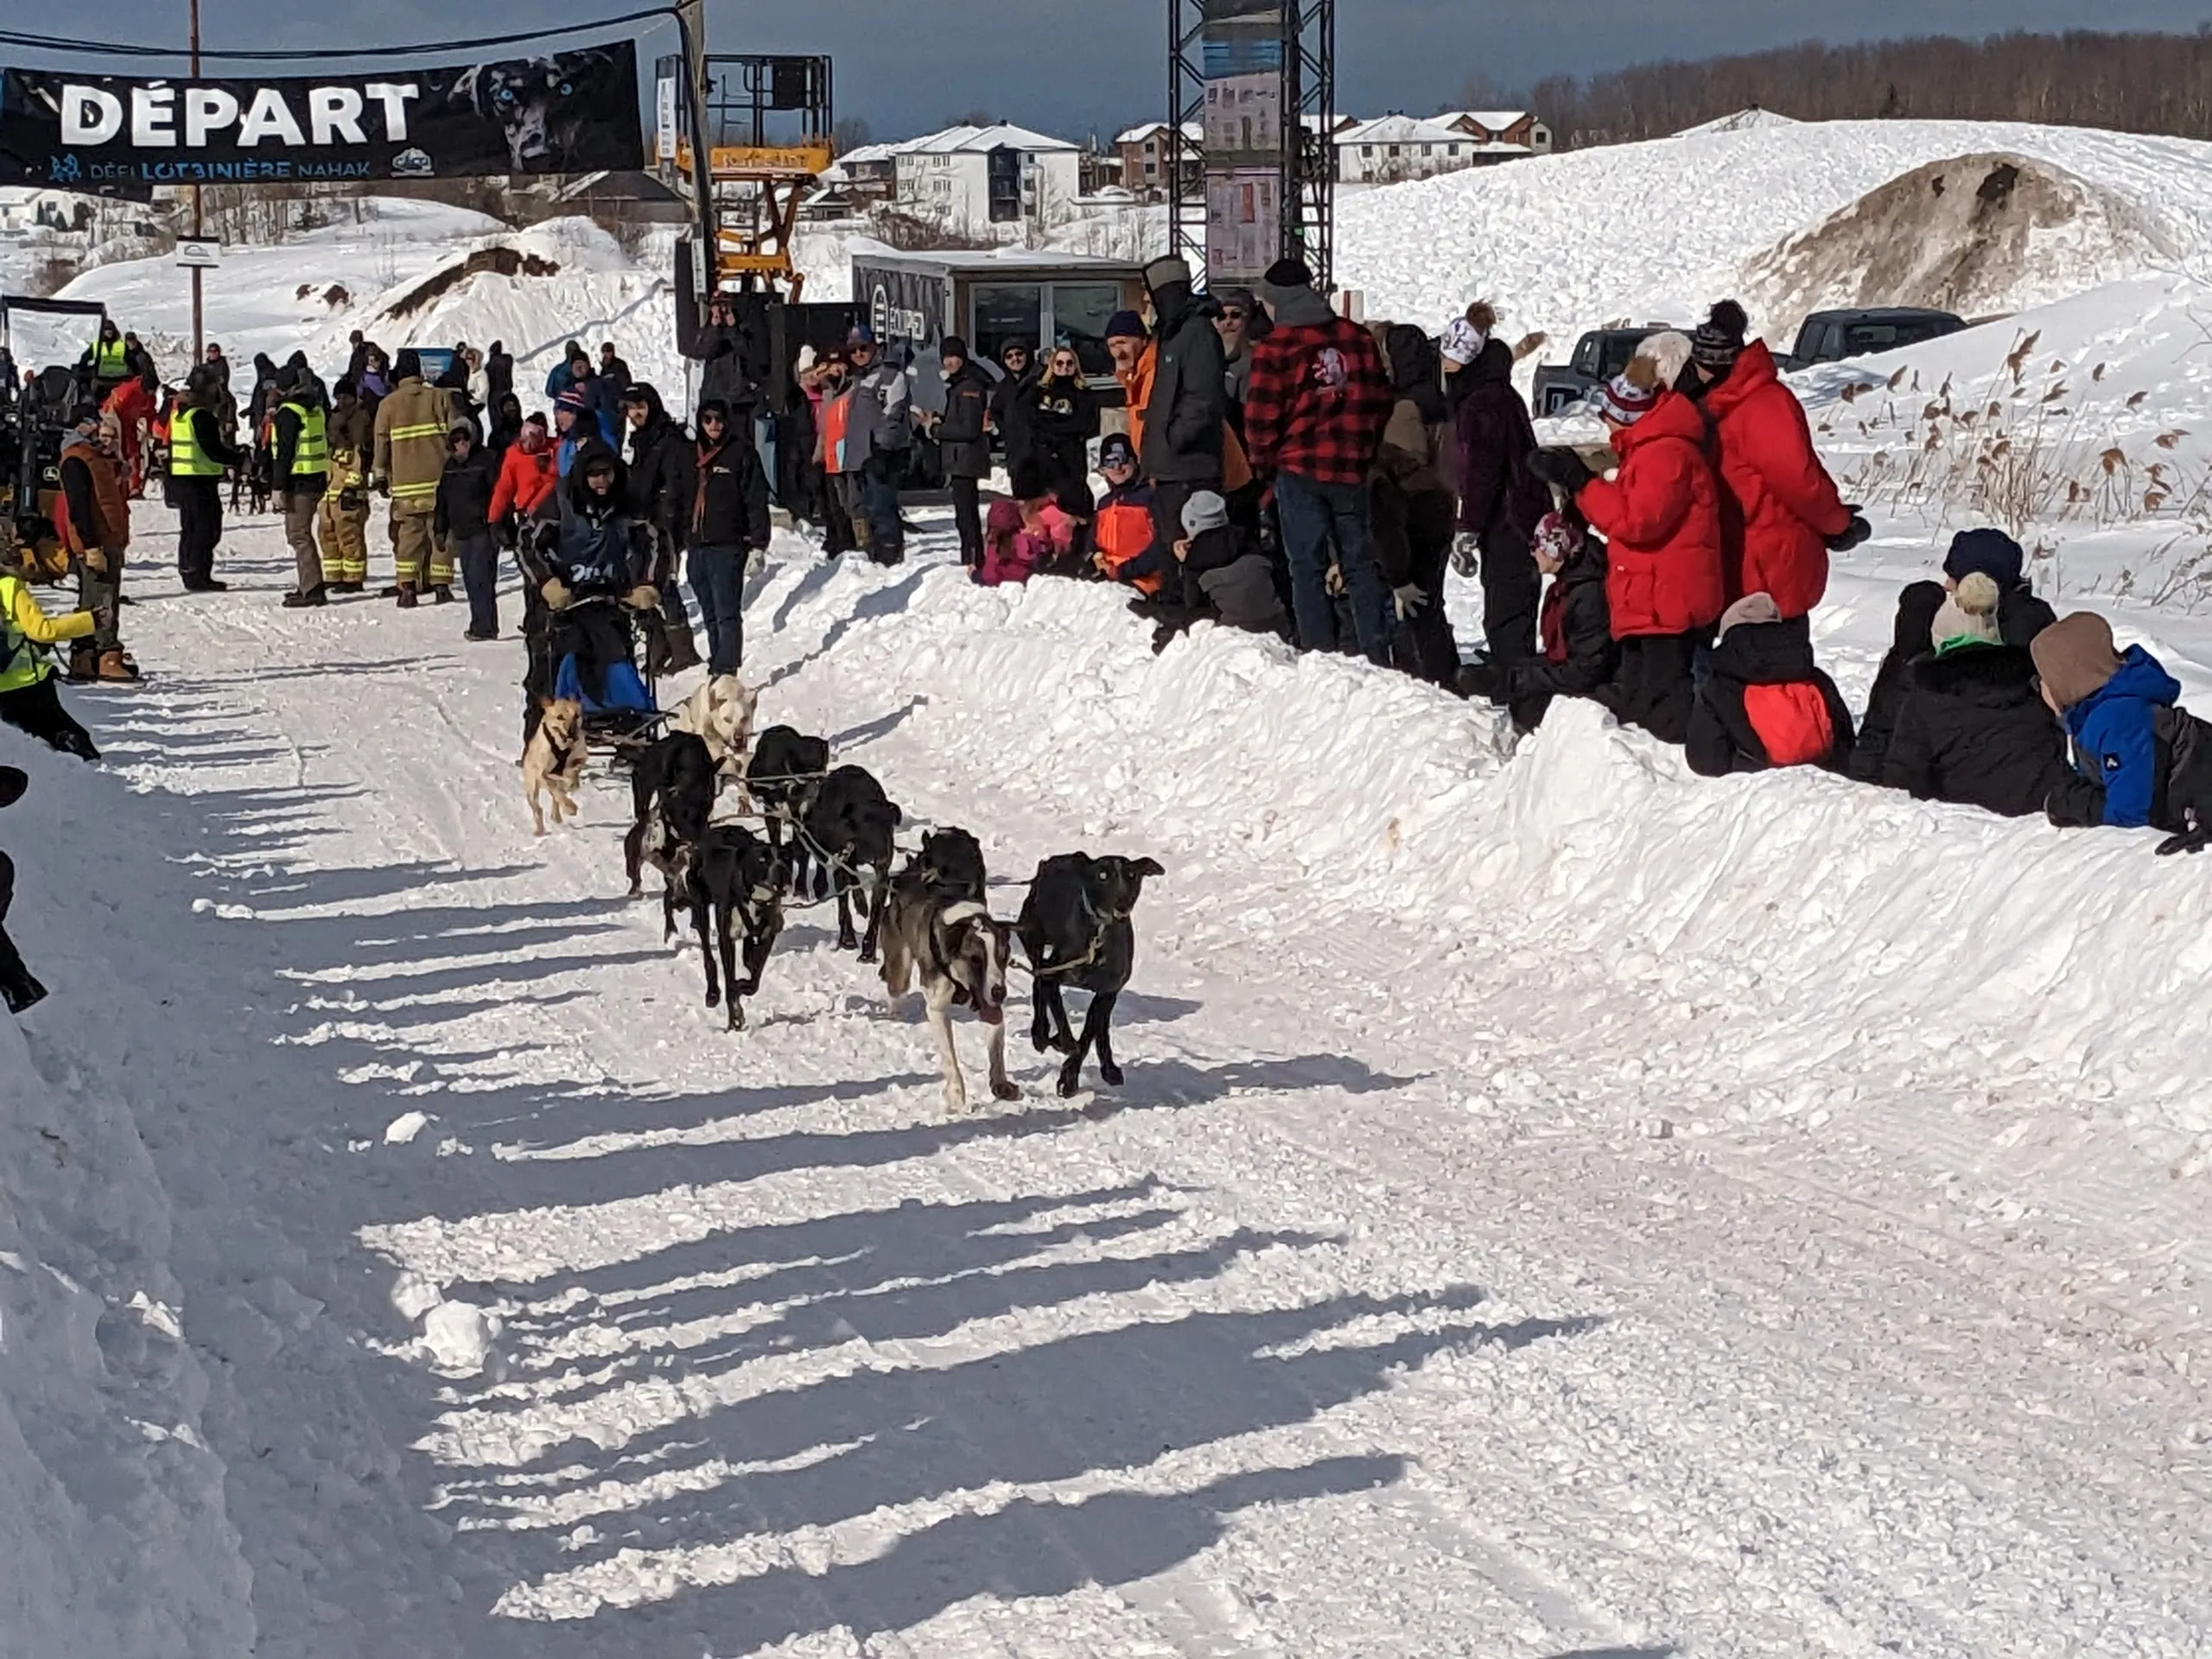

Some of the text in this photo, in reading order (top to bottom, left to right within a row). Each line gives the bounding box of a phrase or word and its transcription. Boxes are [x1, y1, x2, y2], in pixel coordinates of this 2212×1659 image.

[60, 80, 420, 147] DÉPART
[89, 162, 135, 179] DÉFI
[297, 162, 371, 176] NAHAK
